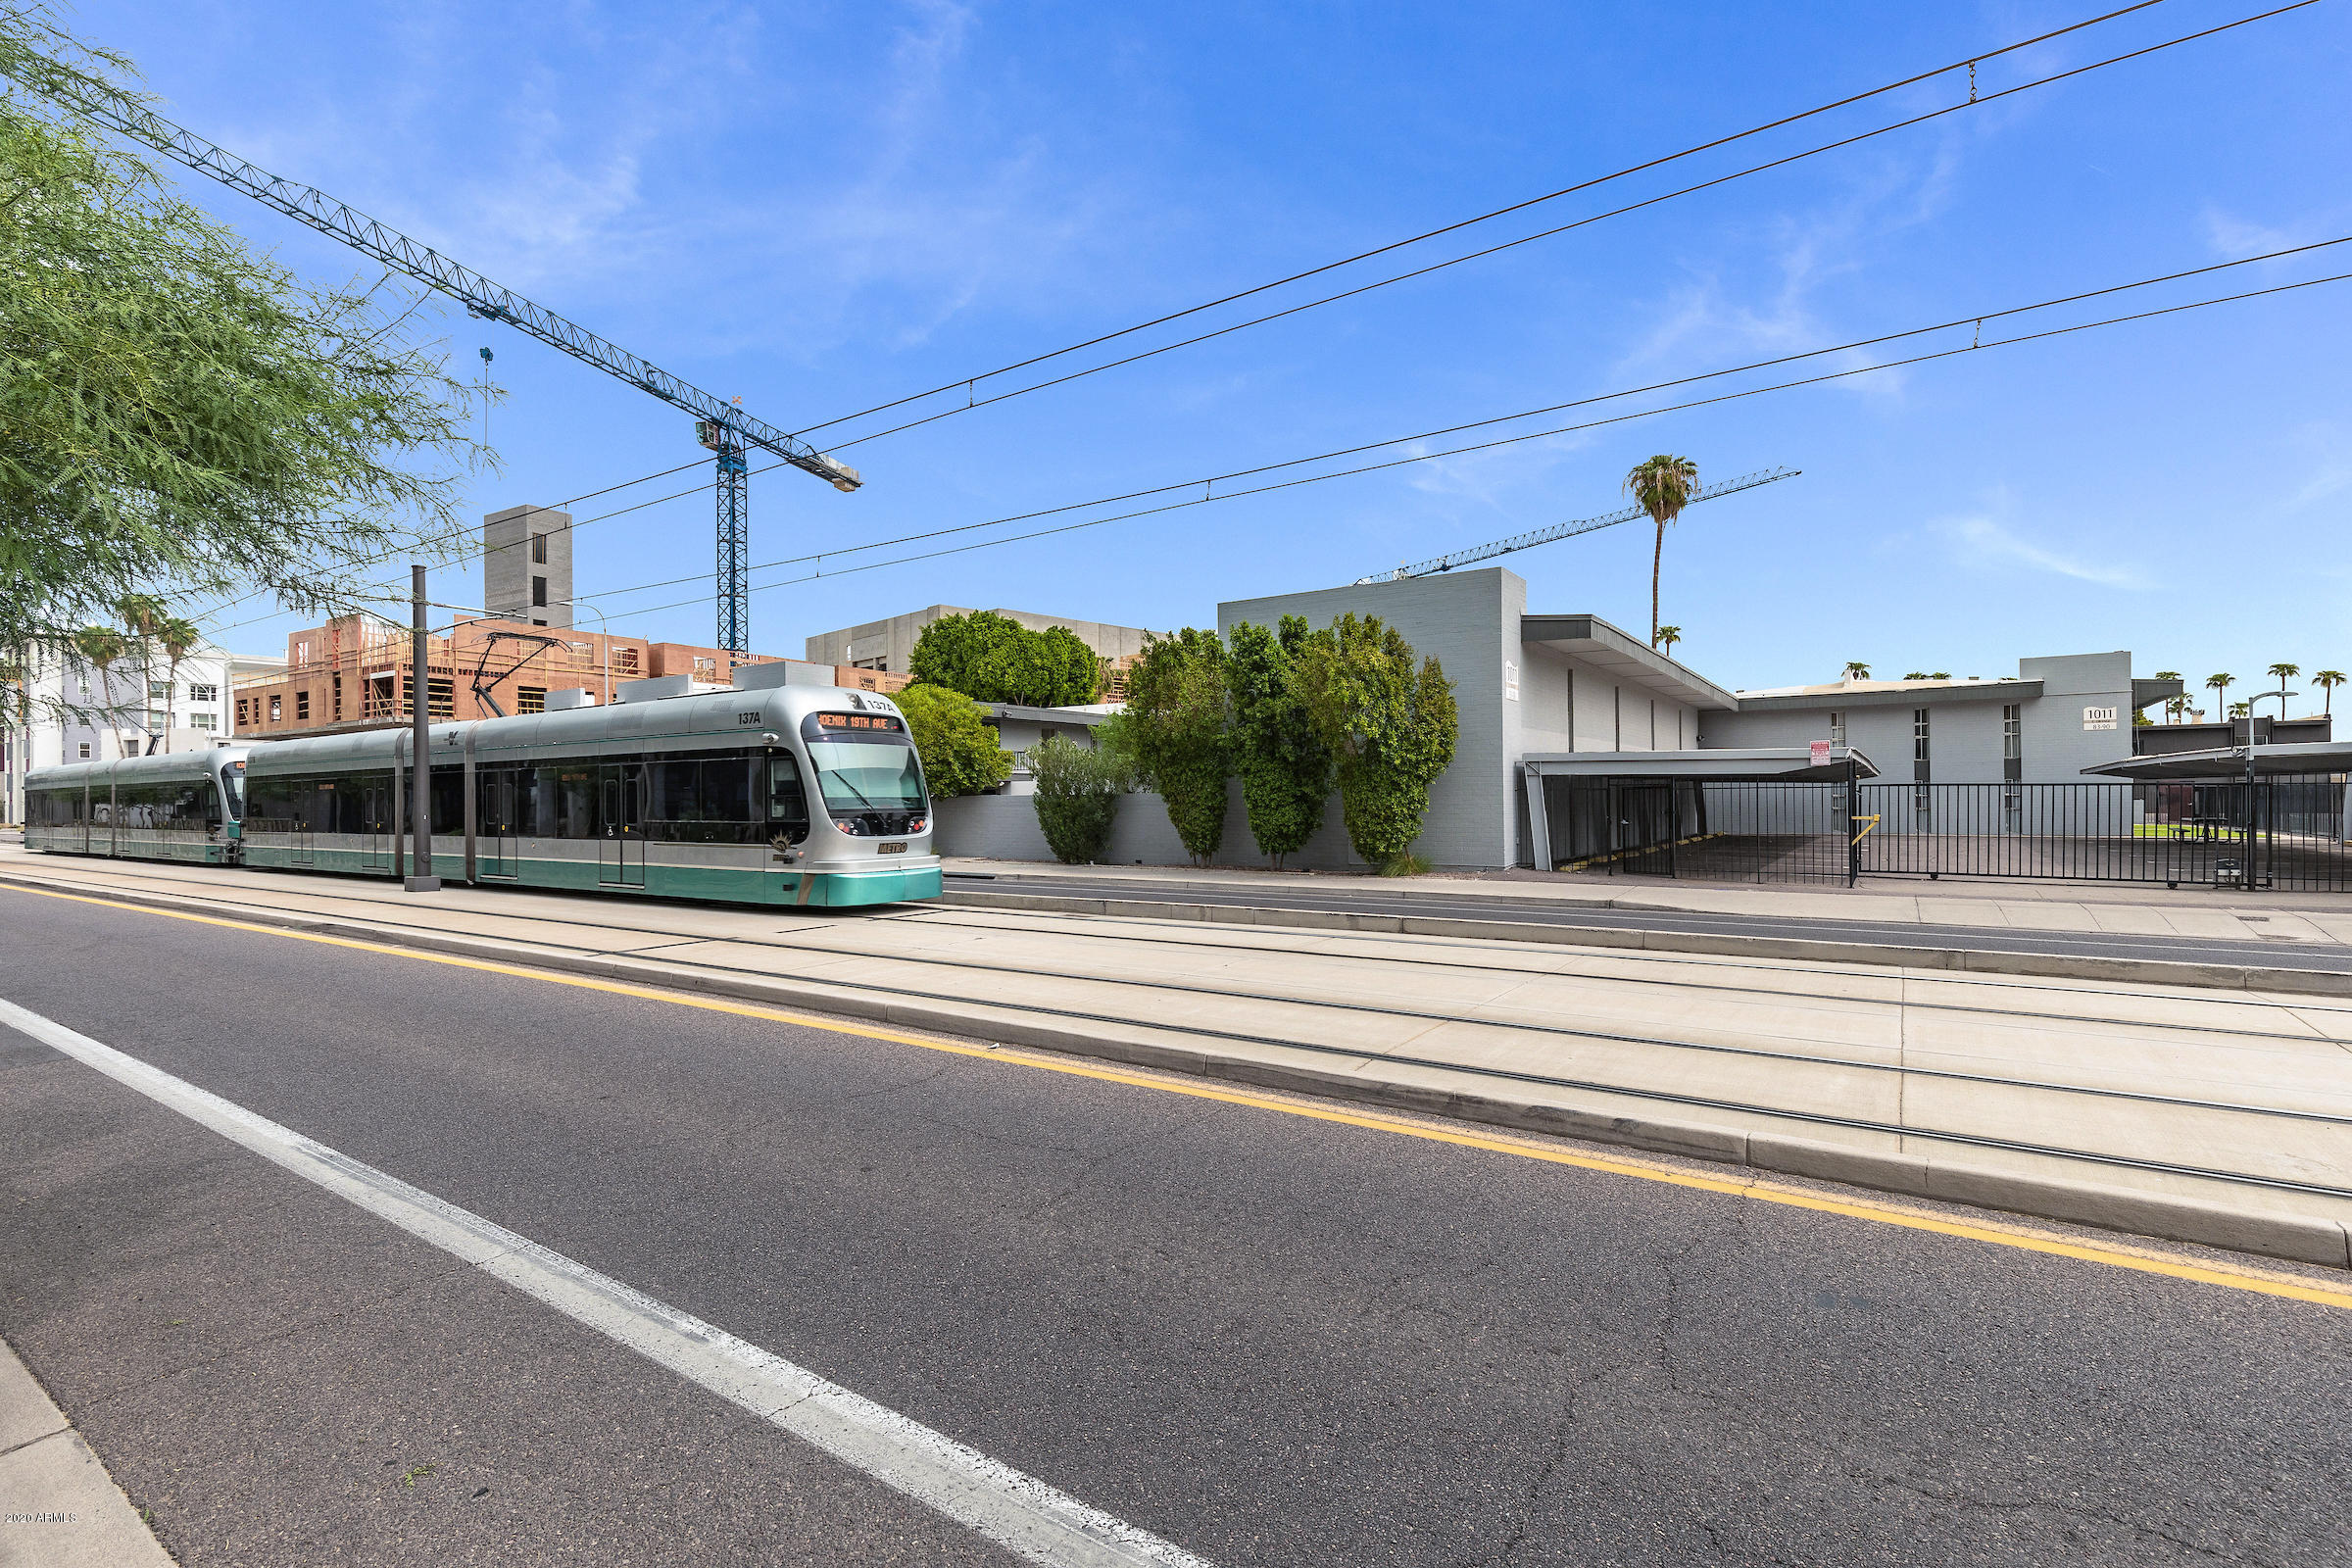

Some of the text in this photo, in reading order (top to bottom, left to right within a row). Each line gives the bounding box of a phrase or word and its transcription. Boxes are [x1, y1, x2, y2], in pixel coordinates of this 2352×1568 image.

[866, 700, 896, 713] 137A
[738, 711, 760, 725] 137A
[2088, 709, 2112, 719] 1011
[850, 716, 870, 728] 19TH
[872, 717, 889, 730] AVE
[877, 842, 908, 855] METRO
